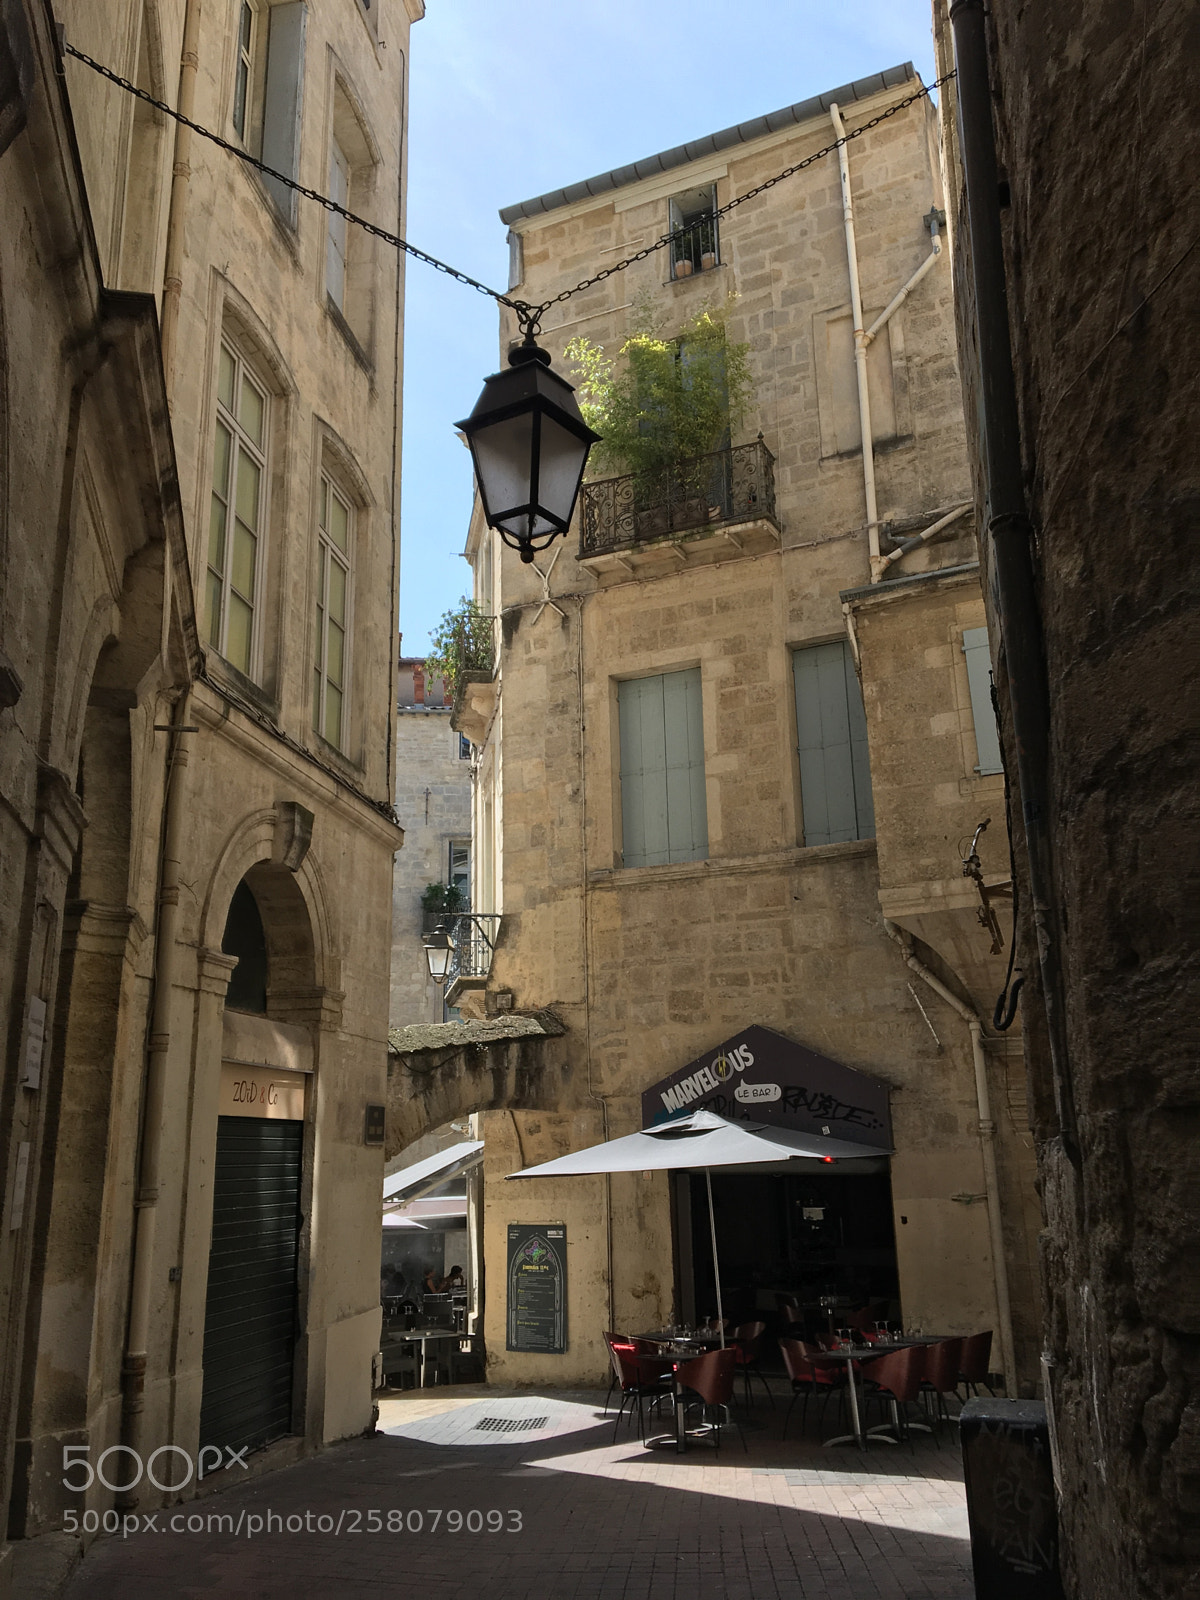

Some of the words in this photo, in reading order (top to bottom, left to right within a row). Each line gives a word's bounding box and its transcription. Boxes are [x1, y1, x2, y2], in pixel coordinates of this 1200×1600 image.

[660, 1043, 754, 1114] MARVELOUS
[260, 1086, 265, 1104] &
[738, 1089, 749, 1098] LE
[753, 1088, 770, 1097] BAR
